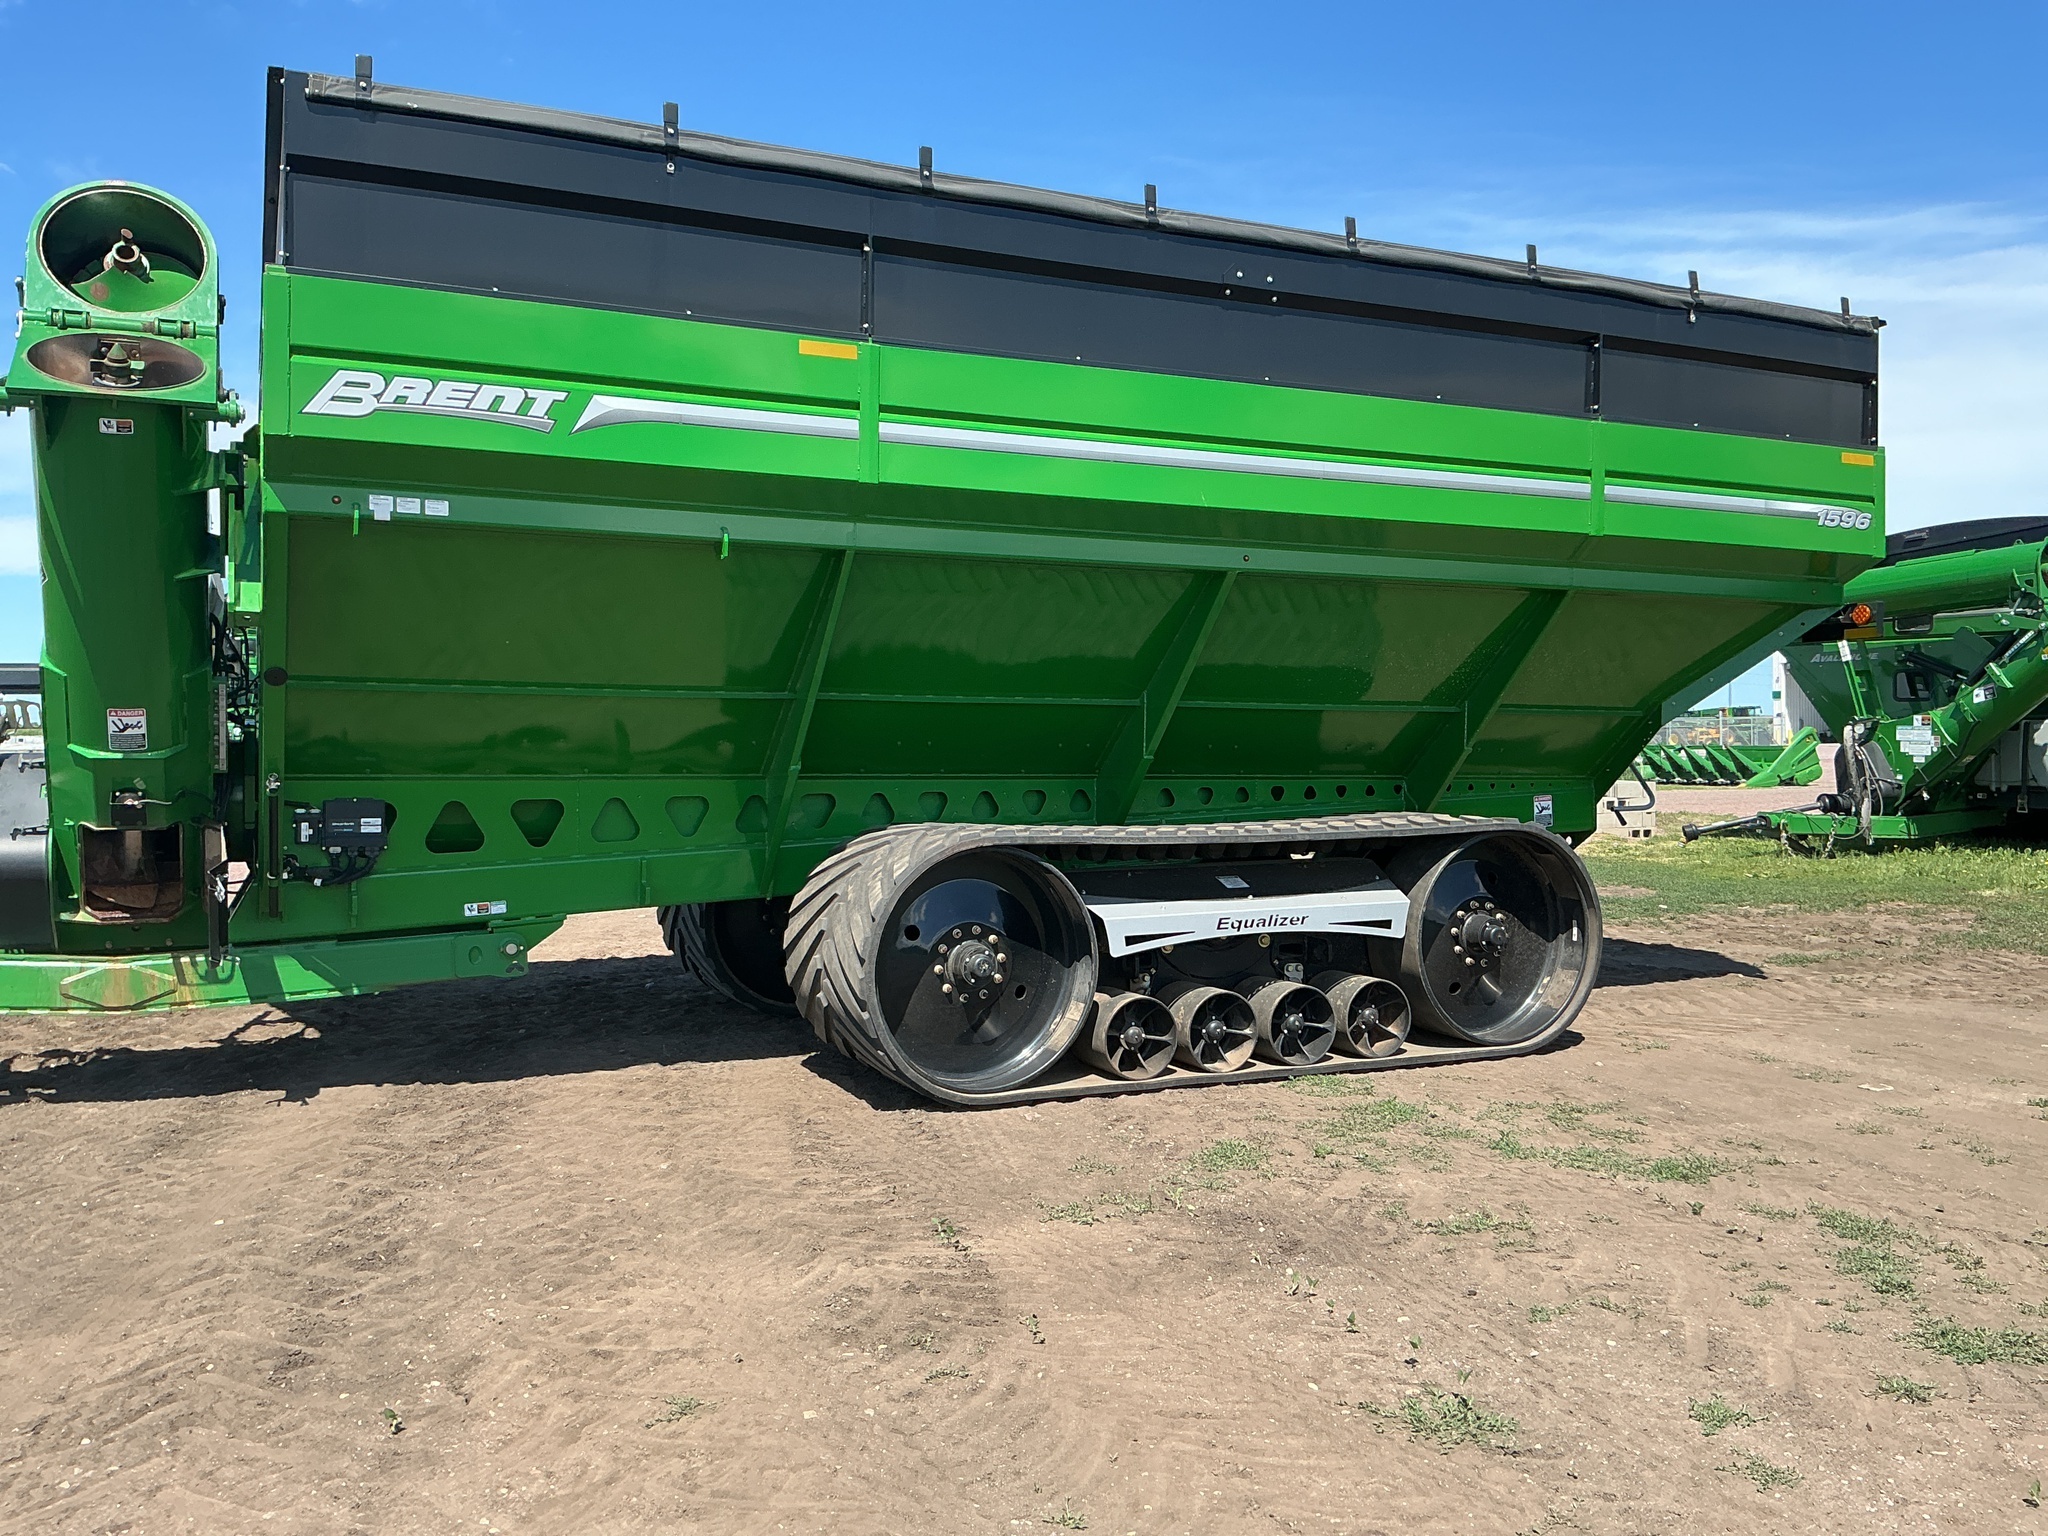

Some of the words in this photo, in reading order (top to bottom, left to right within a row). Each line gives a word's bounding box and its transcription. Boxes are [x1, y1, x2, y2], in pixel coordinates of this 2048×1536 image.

[301, 368, 571, 420] BRENT
[1817, 509, 1872, 530] 1596
[1809, 652, 1879, 663] AVALNCE
[1216, 914, 1310, 932] Equalizer
